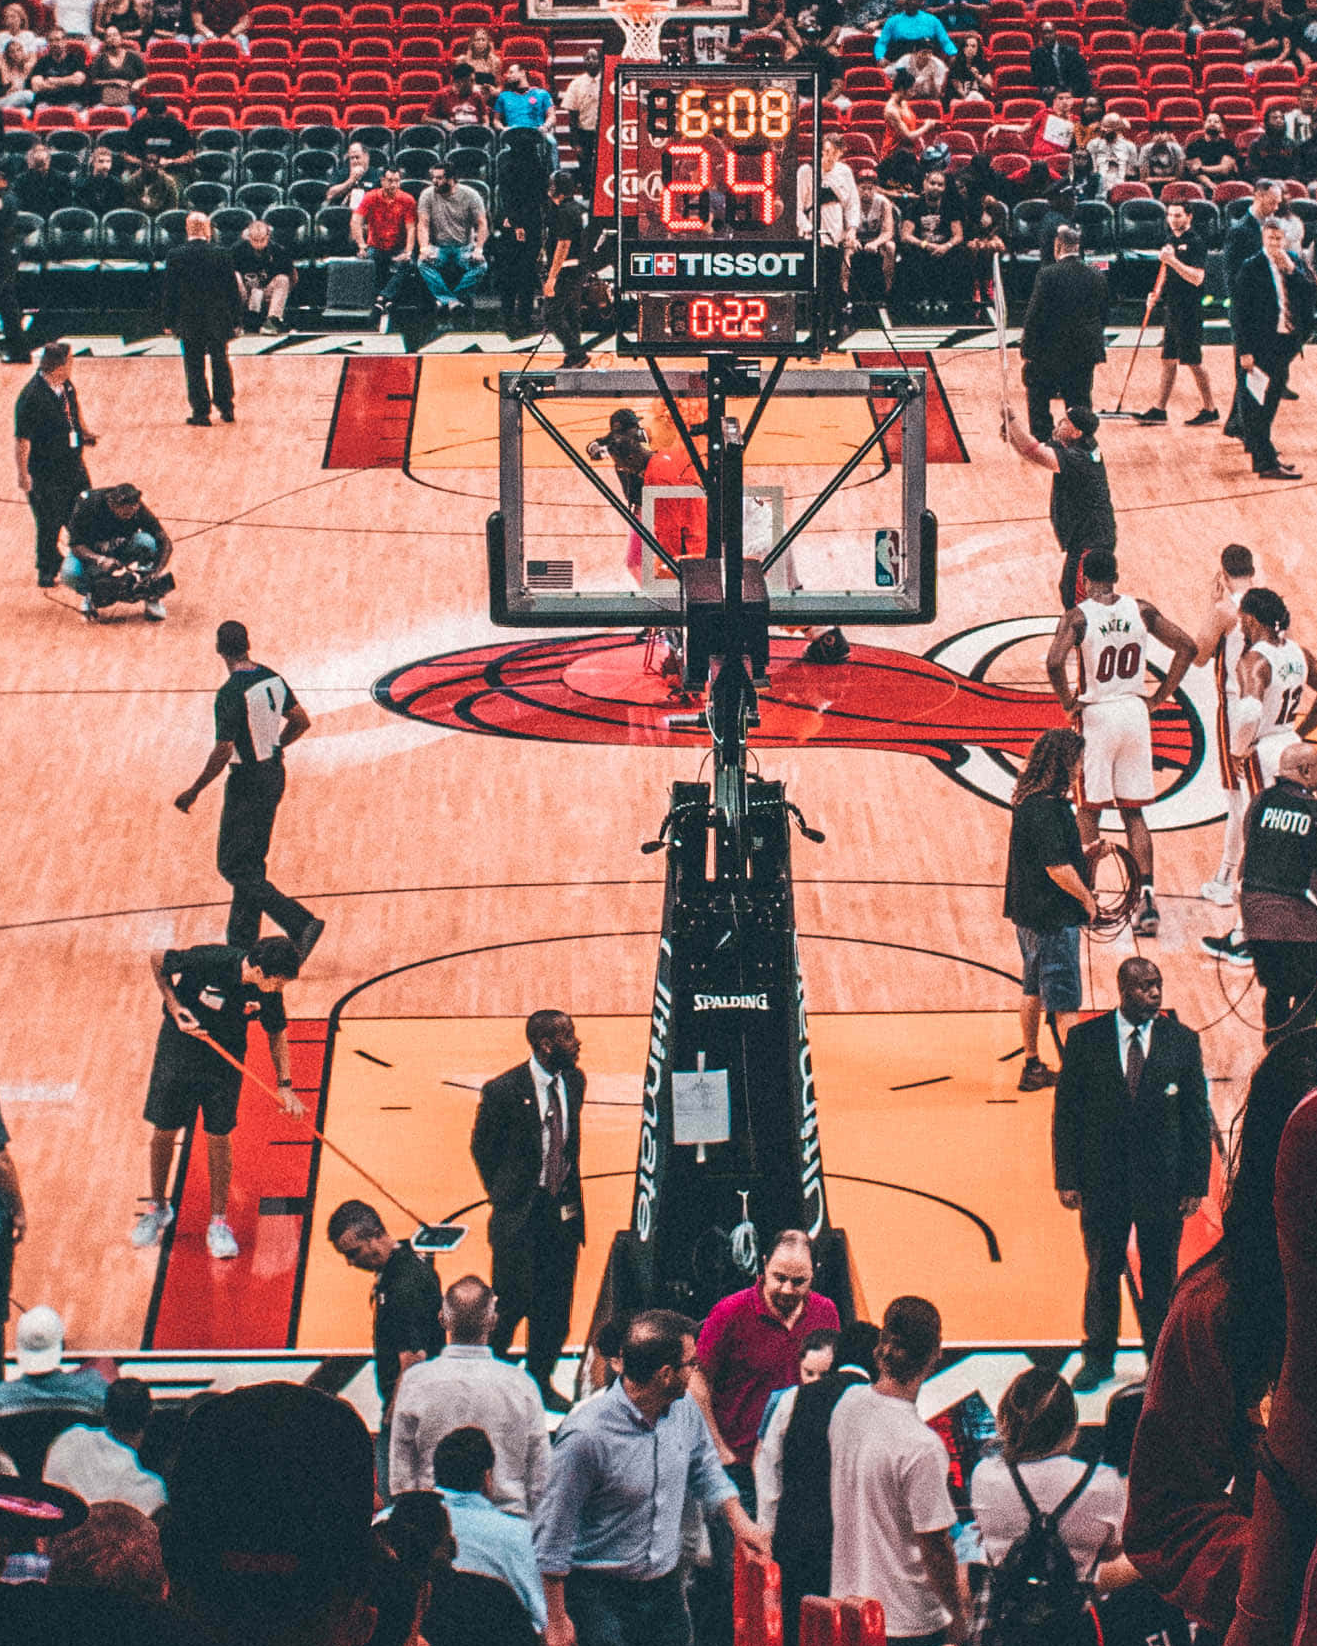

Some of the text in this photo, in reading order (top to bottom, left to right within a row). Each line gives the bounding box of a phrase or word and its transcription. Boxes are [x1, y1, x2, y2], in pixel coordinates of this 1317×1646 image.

[680, 88, 791, 139] 6:08
[660, 143, 775, 233] 24
[679, 253, 805, 276] TISSOT
[688, 299, 766, 338] 0:22
[1095, 642, 1142, 684] 00
[1275, 685, 1303, 726] 12
[1260, 807, 1311, 836] PHOTO
[693, 993, 770, 1012] SPALDING
[637, 936, 673, 1243] Ultimate
